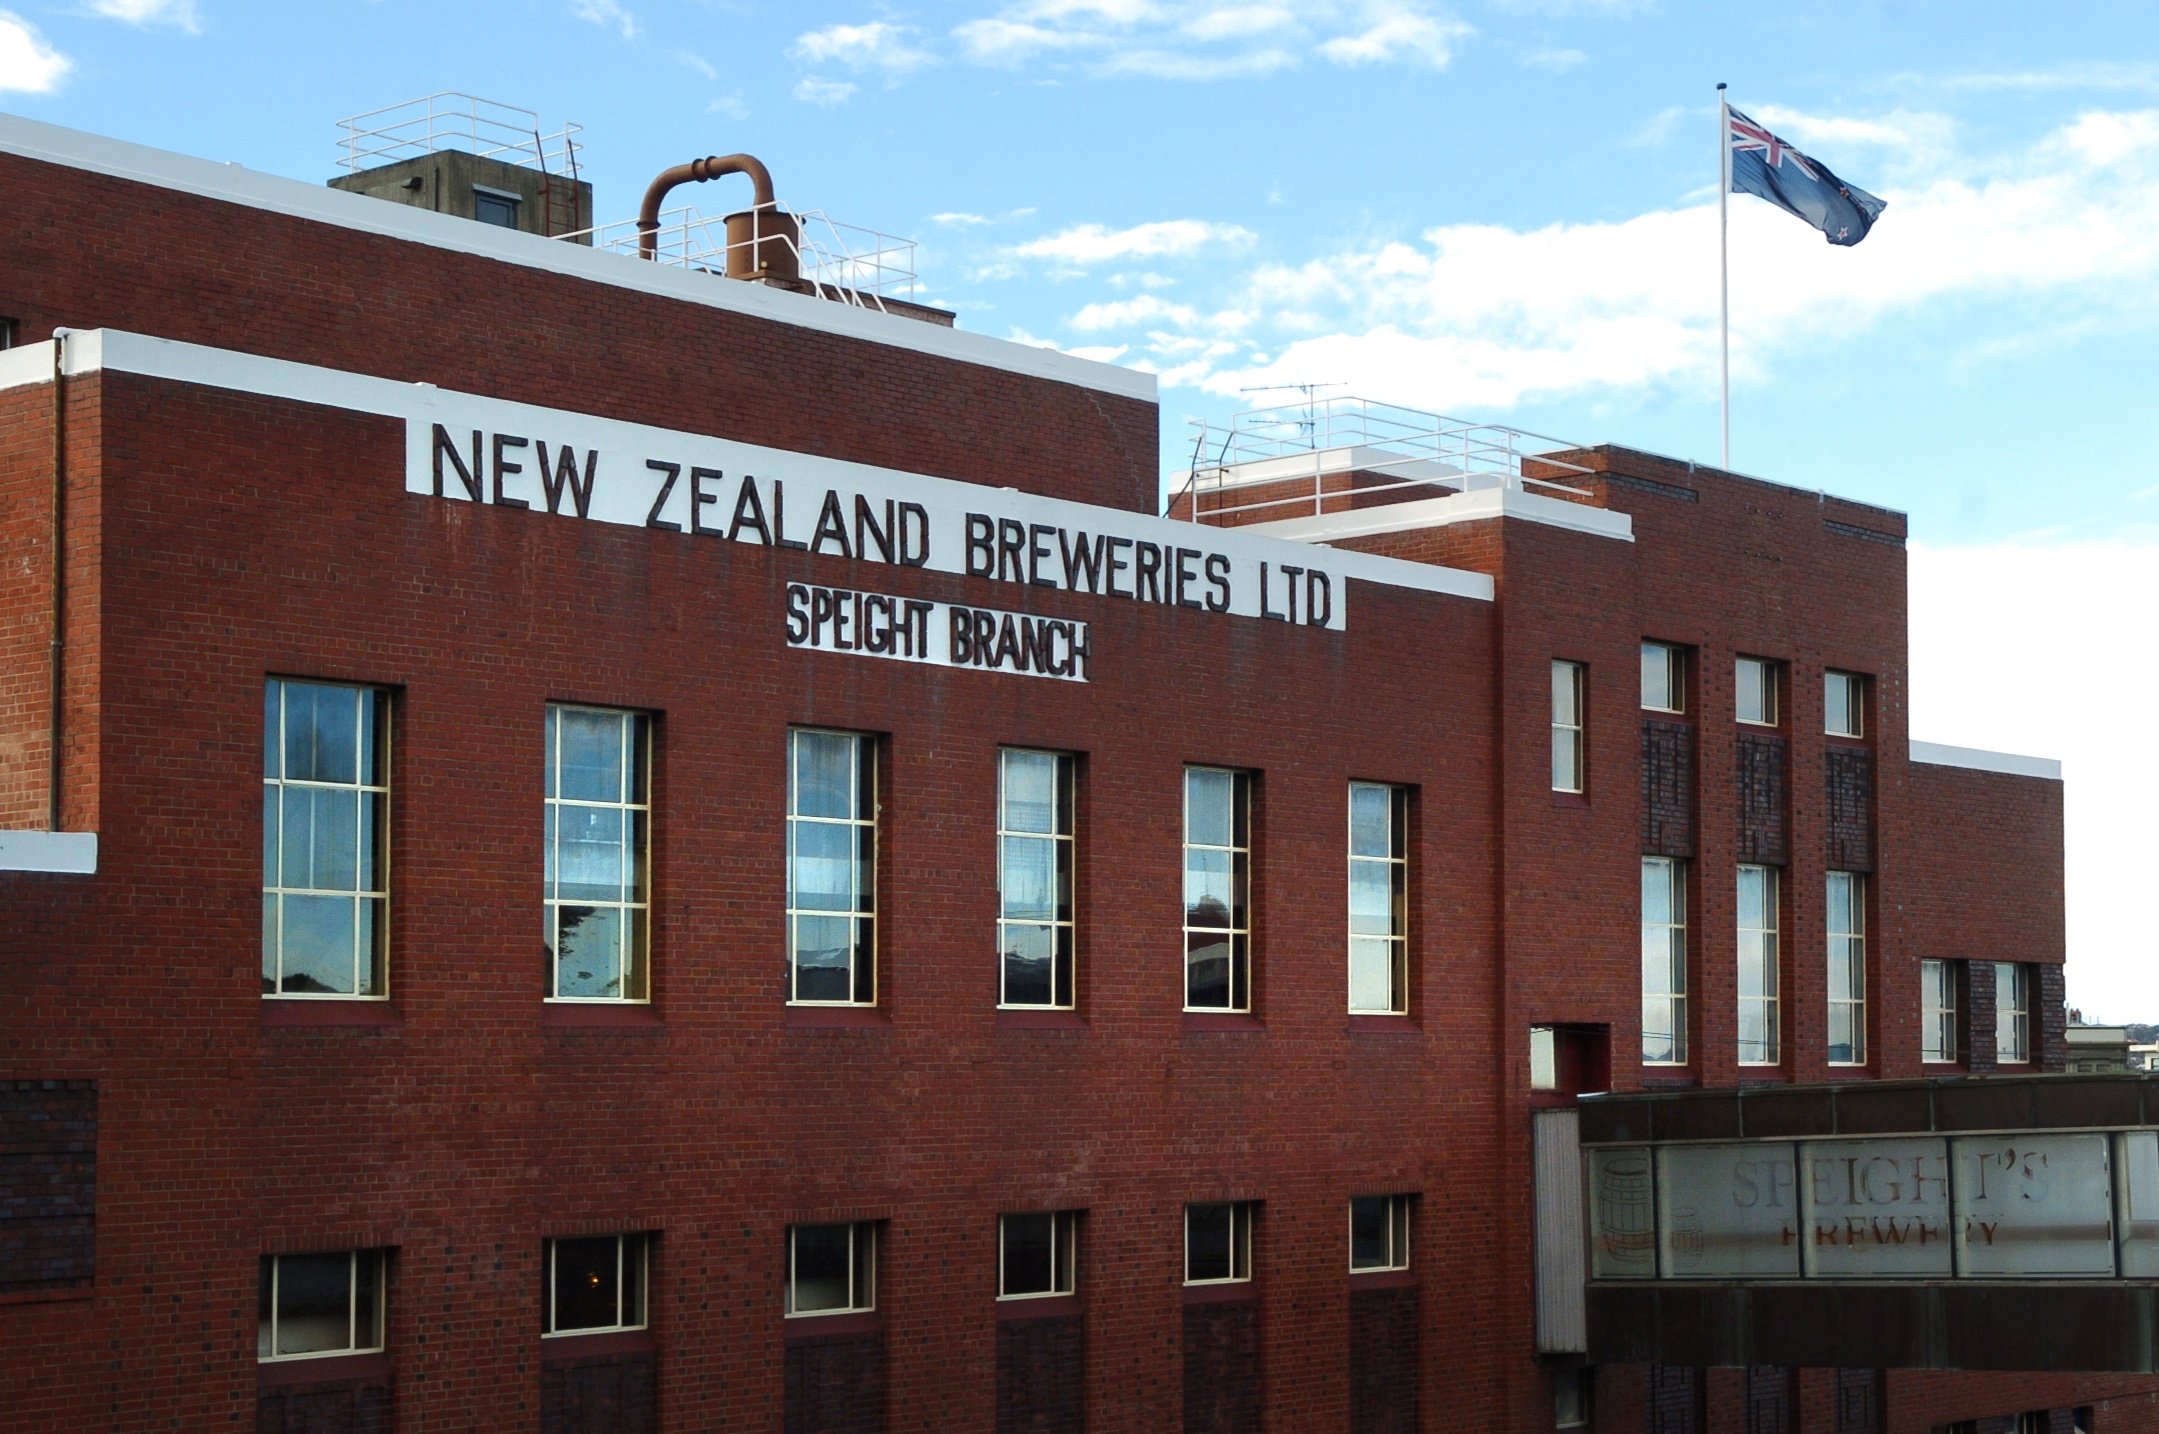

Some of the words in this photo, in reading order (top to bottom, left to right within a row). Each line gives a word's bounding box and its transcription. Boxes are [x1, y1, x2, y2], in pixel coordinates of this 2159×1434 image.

[432, 423, 598, 517] NEW
[645, 458, 931, 567] ZEALAND
[964, 511, 1232, 614] BREWERIES
[1260, 561, 1331, 628] LTD
[786, 583, 934, 660] SPEIGHT
[949, 606, 1091, 682] BRANCH
